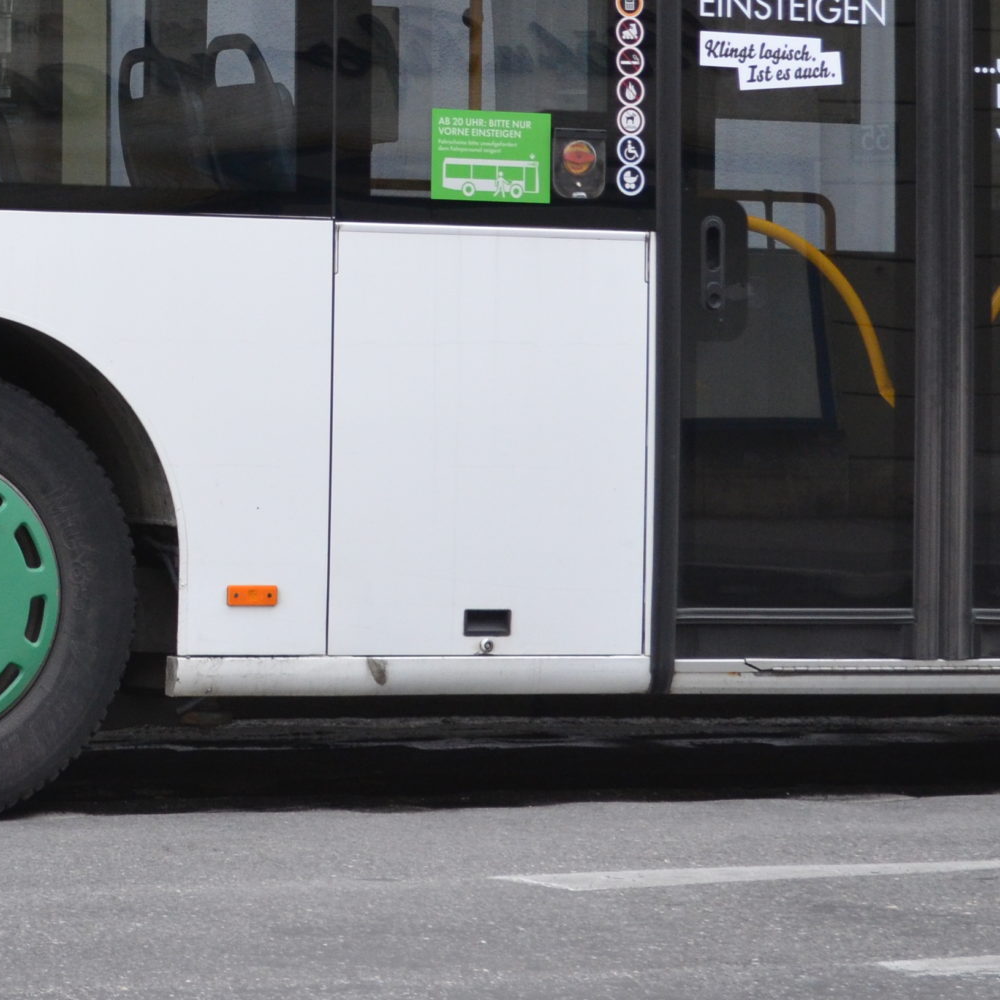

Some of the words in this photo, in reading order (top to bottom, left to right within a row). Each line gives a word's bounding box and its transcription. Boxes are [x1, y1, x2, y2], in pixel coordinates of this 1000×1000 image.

[704, 38, 757, 64] Klingt
[759, 42, 817, 65] logisch.
[746, 64, 774, 83] Ist
[776, 66, 791, 81] es
[794, 60, 836, 80] auch.
[438, 116, 451, 126] AB
[452, 117, 464, 127] 20
[465, 118, 487, 128] UHR:
[488, 119, 510, 129] BITTE
[512, 120, 533, 130] NUR
[438, 127, 470, 137] VORNE
[471, 128, 522, 139] EINSTEIGEN
